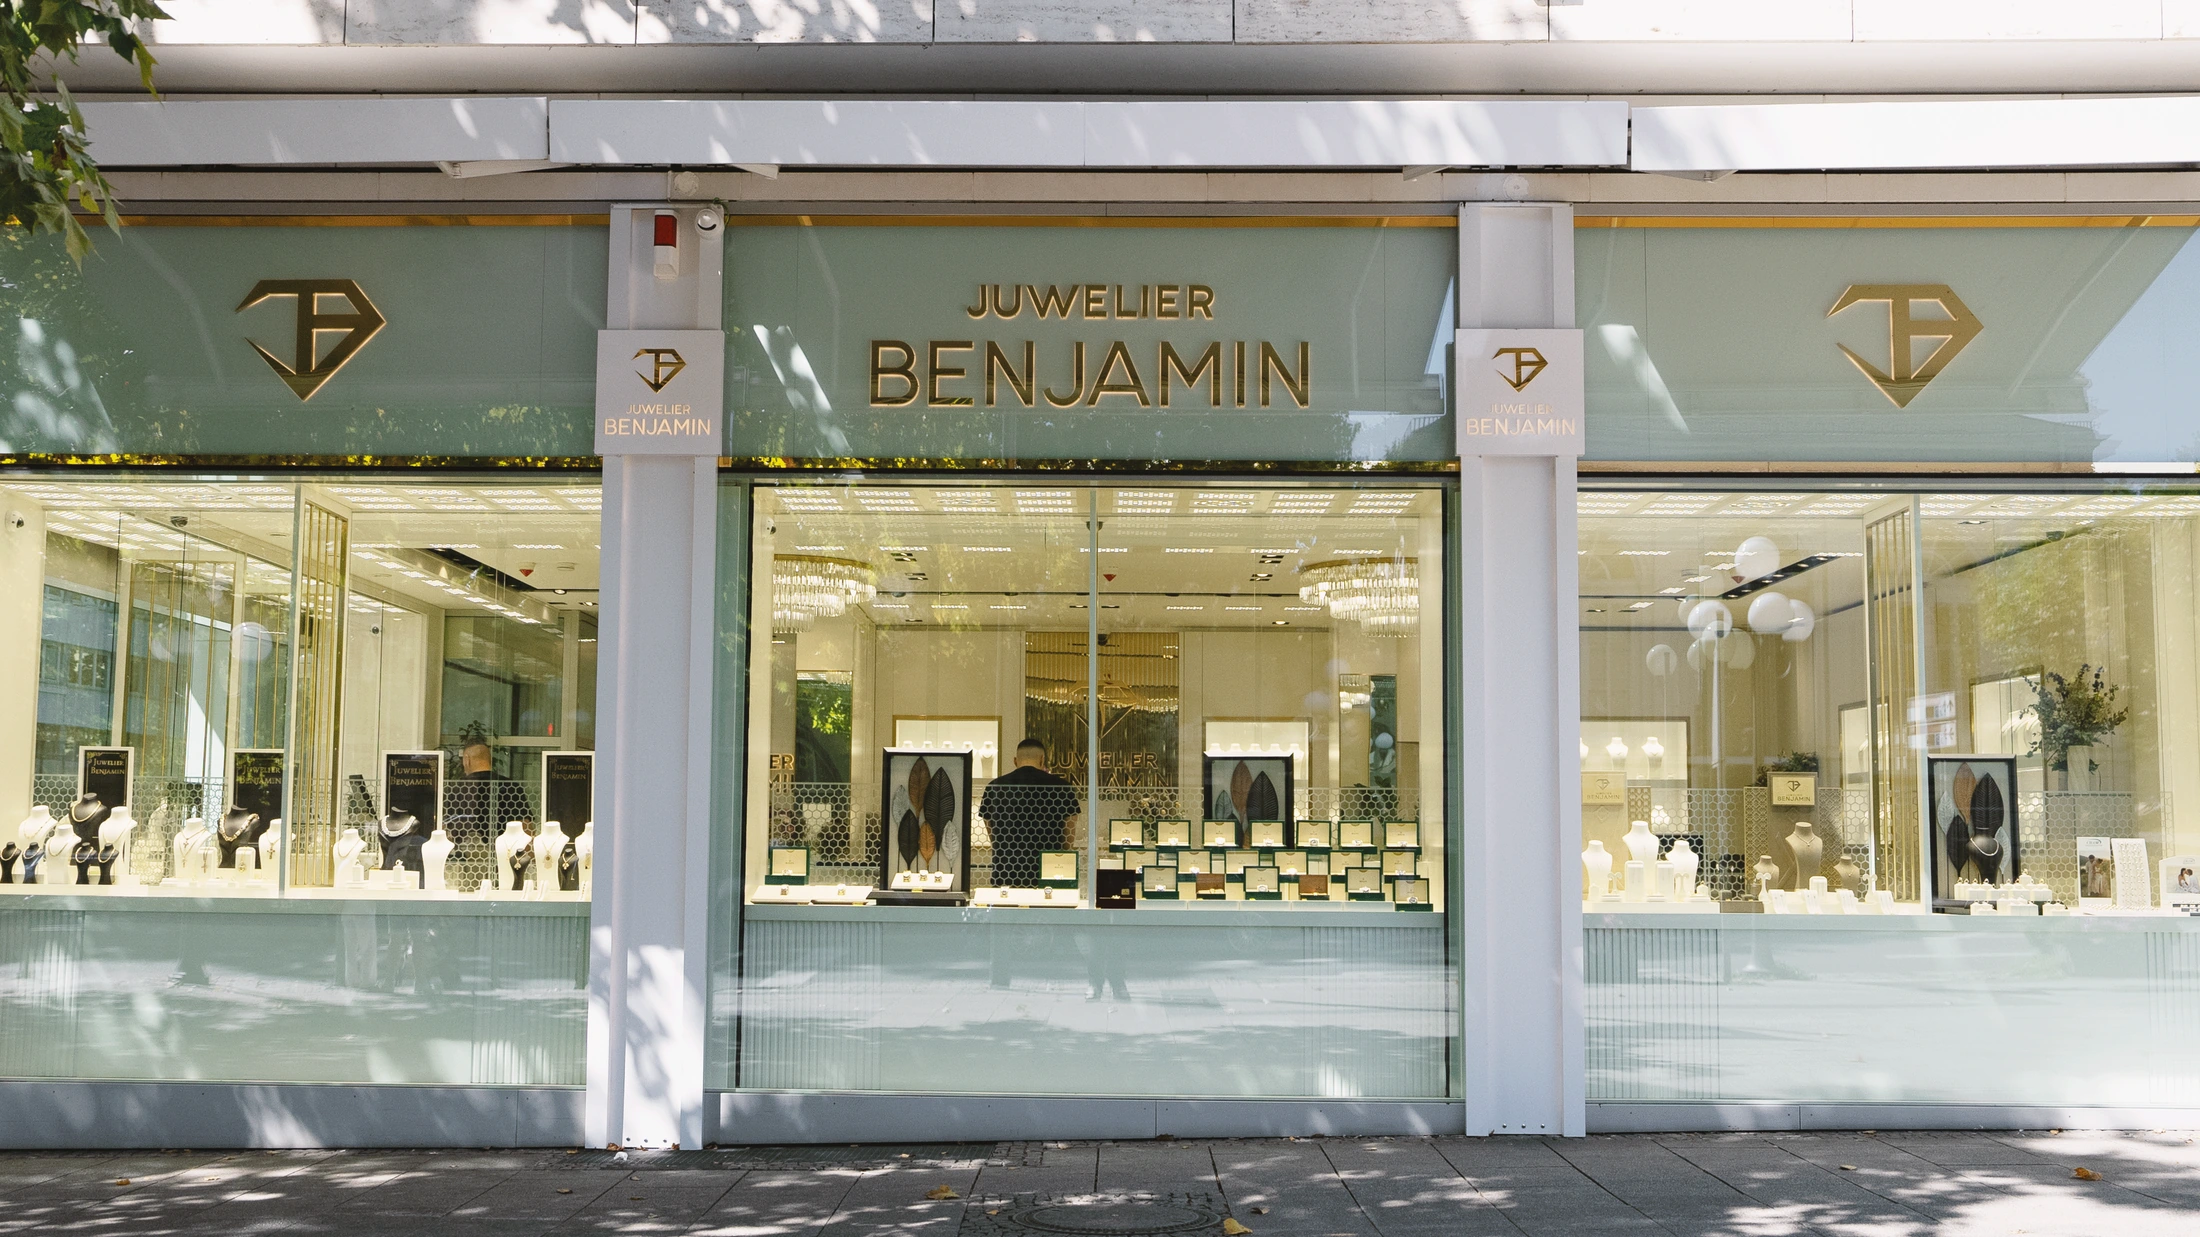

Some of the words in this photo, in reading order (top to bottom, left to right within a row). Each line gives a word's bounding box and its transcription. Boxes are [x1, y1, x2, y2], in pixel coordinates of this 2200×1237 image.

[966, 284, 1216, 320] JUWELIER
[869, 340, 1310, 408] BENJAMIN
[626, 404, 691, 415] JUWELIER
[1490, 403, 1554, 415] JUWELIER
[604, 418, 711, 436] BENJAMIN
[1466, 418, 1576, 436] BENJAMIN
[93, 758, 124, 766] JUWELIER
[91, 766, 125, 775] BENJAMIN
[393, 766, 432, 775] JUWELIER
[551, 771, 587, 780] BENJAMIN
[390, 776, 433, 786] BENJAMIN
